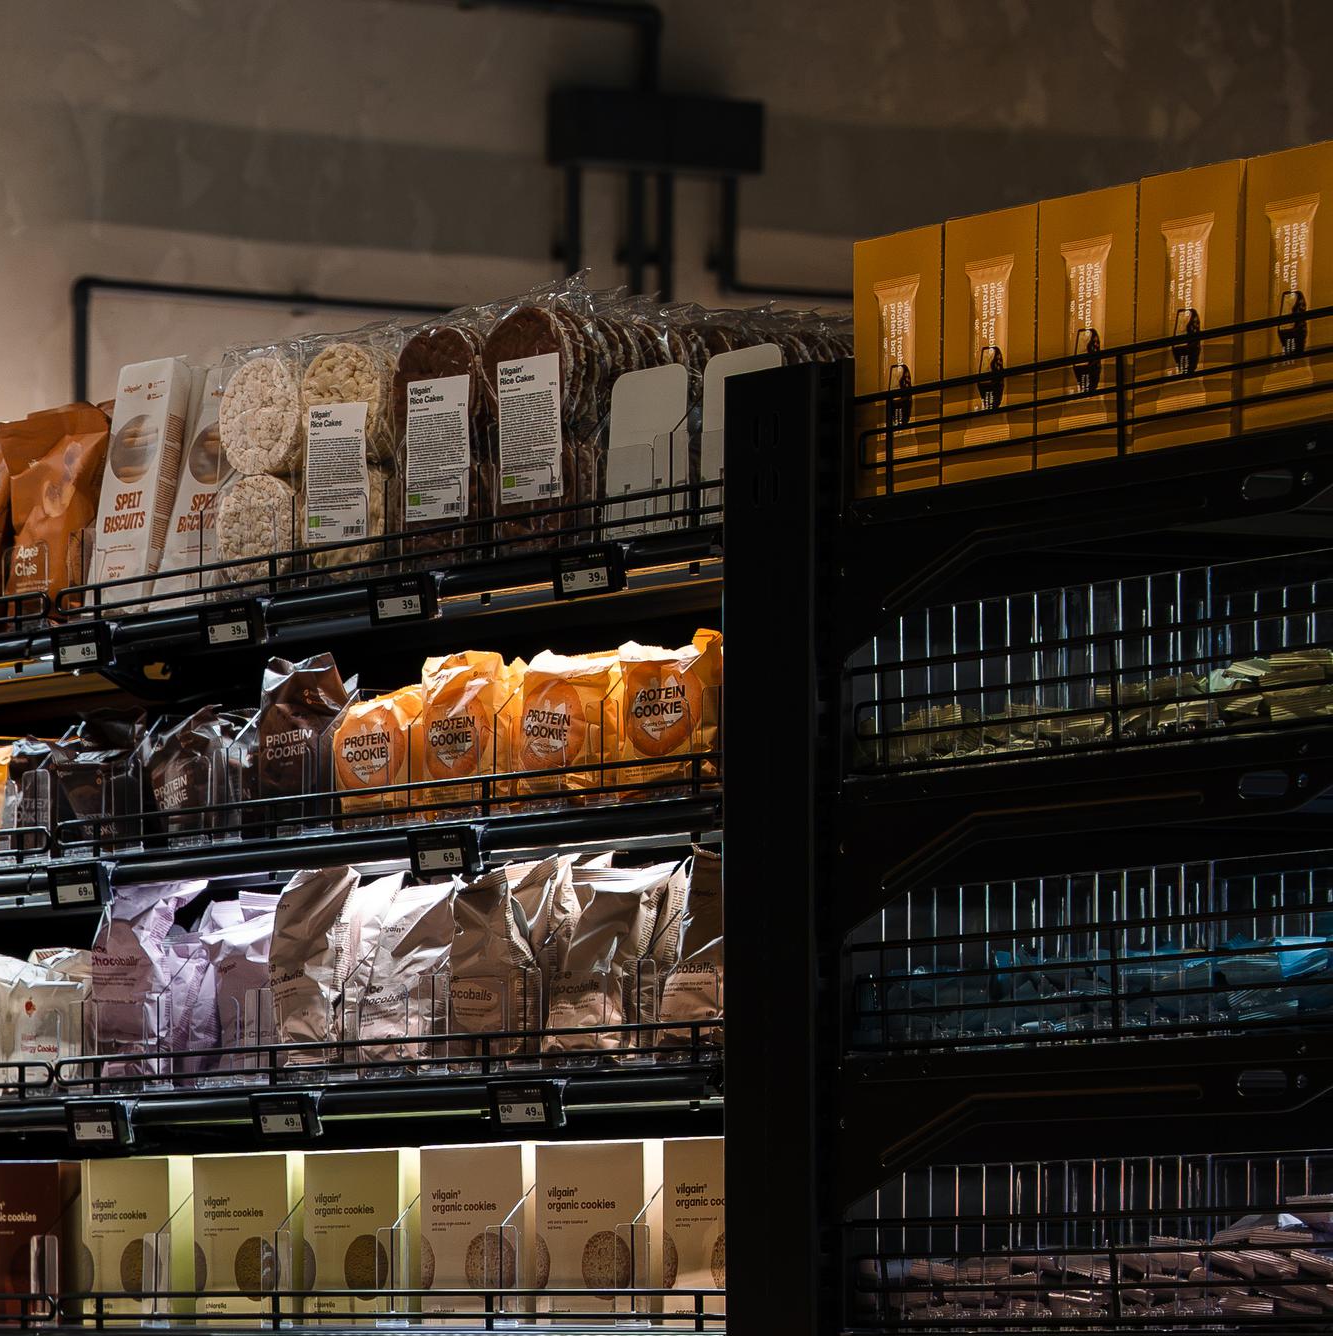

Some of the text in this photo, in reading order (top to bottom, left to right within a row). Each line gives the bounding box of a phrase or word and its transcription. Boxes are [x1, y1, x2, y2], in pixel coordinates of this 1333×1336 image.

[500, 366, 524, 375] Vilgain
[500, 374, 535, 386] Rice Cakes
[409, 386, 433, 395] Vilgain
[409, 394, 444, 405] Rice Cakes
[311, 410, 332, 419] Vilgain
[323, 419, 342, 427] Cakes
[115, 491, 143, 512] SPELT
[103, 511, 146, 534] BISCUITS
[589, 572, 601, 582] 39
[402, 599, 413, 609] 39
[231, 626, 241, 635] 39
[81, 647, 90, 656] 49
[635, 701, 682, 718] COOKIE
[430, 715, 475, 732] PROTEIN
[526, 709, 570, 727] PROTEIN
[266, 729, 312, 747] PROTEIN
[525, 724, 567, 741] COOKIE
[344, 731, 391, 749] PROTEIN
[432, 731, 472, 747] COOKIE
[266, 744, 307, 760] COOKIE
[346, 747, 388, 763] COOKIE
[154, 775, 188, 799] PROTEIN
[159, 790, 188, 811] COOKIE
[443, 852, 455, 863] 69
[78, 887, 88, 896] 69
[675, 962, 715, 975] coballs
[525, 1107, 537, 1116] 49
[284, 1117, 295, 1127] 49
[97, 1125, 106, 1135] 49
[432, 1189, 461, 1202] vilgain
[547, 1186, 578, 1199] vilgain
[676, 1183, 708, 1196] vilgain
[92, 1199, 117, 1211] vilgain
[204, 1196, 230, 1208] vilgain
[314, 1193, 341, 1205] vilgain
[676, 1197, 708, 1209] organic
[314, 1204, 375, 1217] organic cookies
[432, 1201, 497, 1214] organic cookies
[547, 1199, 616, 1212] organic cookies
[7, 1212, 37, 1222] cookies
[92, 1210, 147, 1222] organic cookies
[204, 1207, 264, 1220] organic cookies
